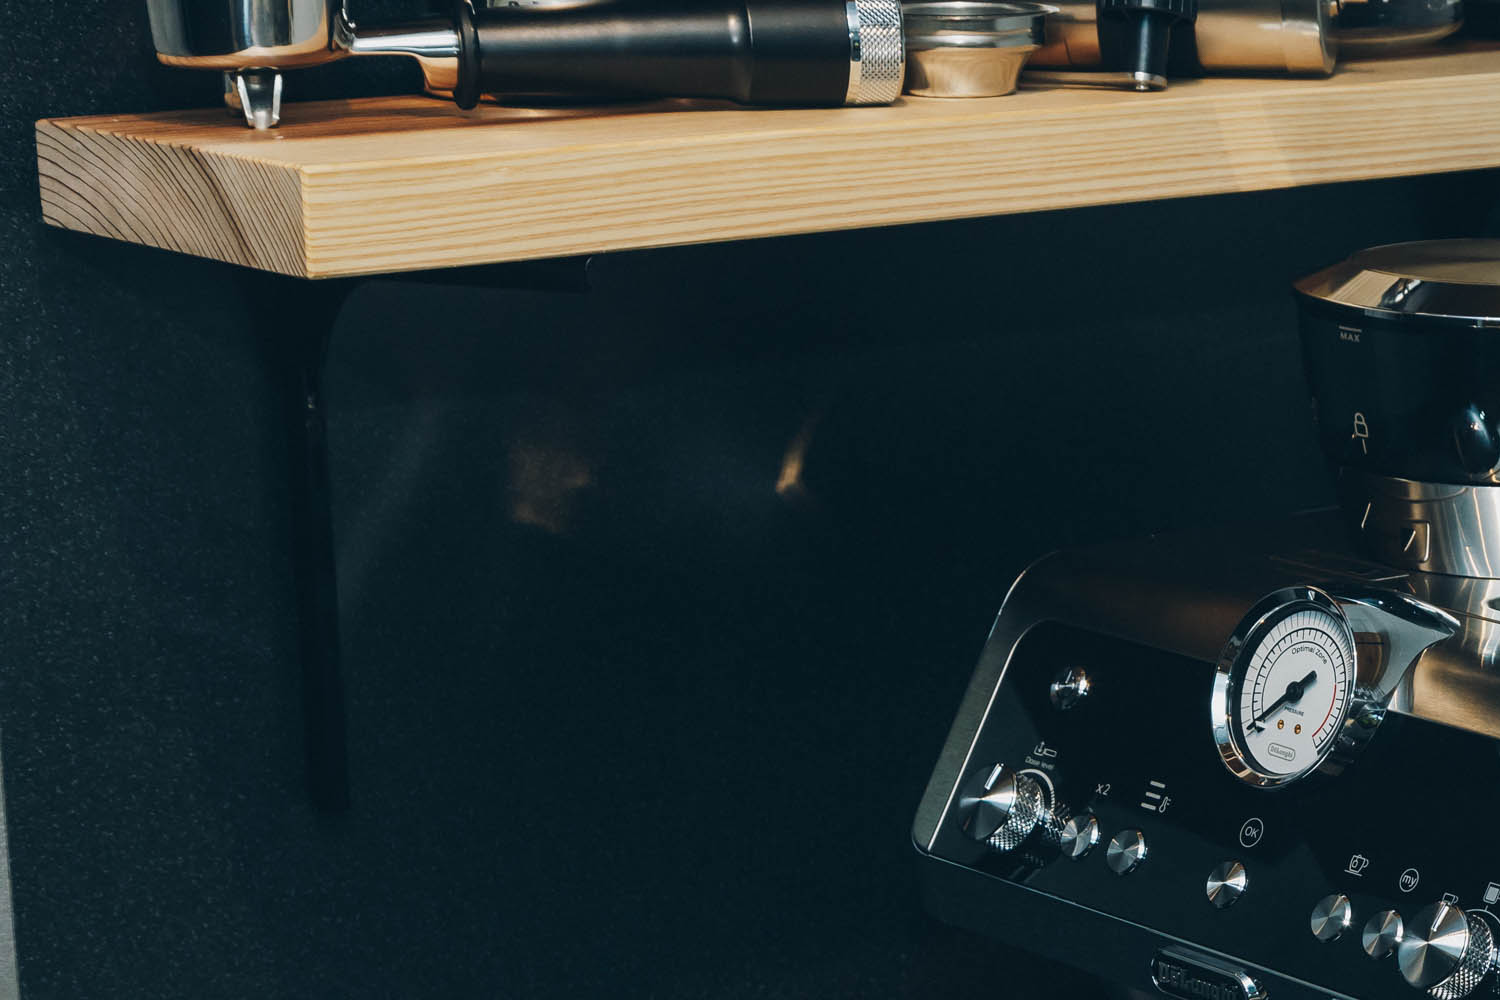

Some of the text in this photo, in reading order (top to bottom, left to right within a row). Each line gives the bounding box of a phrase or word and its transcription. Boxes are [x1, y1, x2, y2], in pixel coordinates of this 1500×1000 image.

[1339, 331, 1361, 343] MAX
[1291, 645, 1328, 665] Optimal Zone
[1284, 706, 1305, 717] PRESSURE
[1244, 825, 1261, 839] OK
[1401, 874, 1417, 888] my
